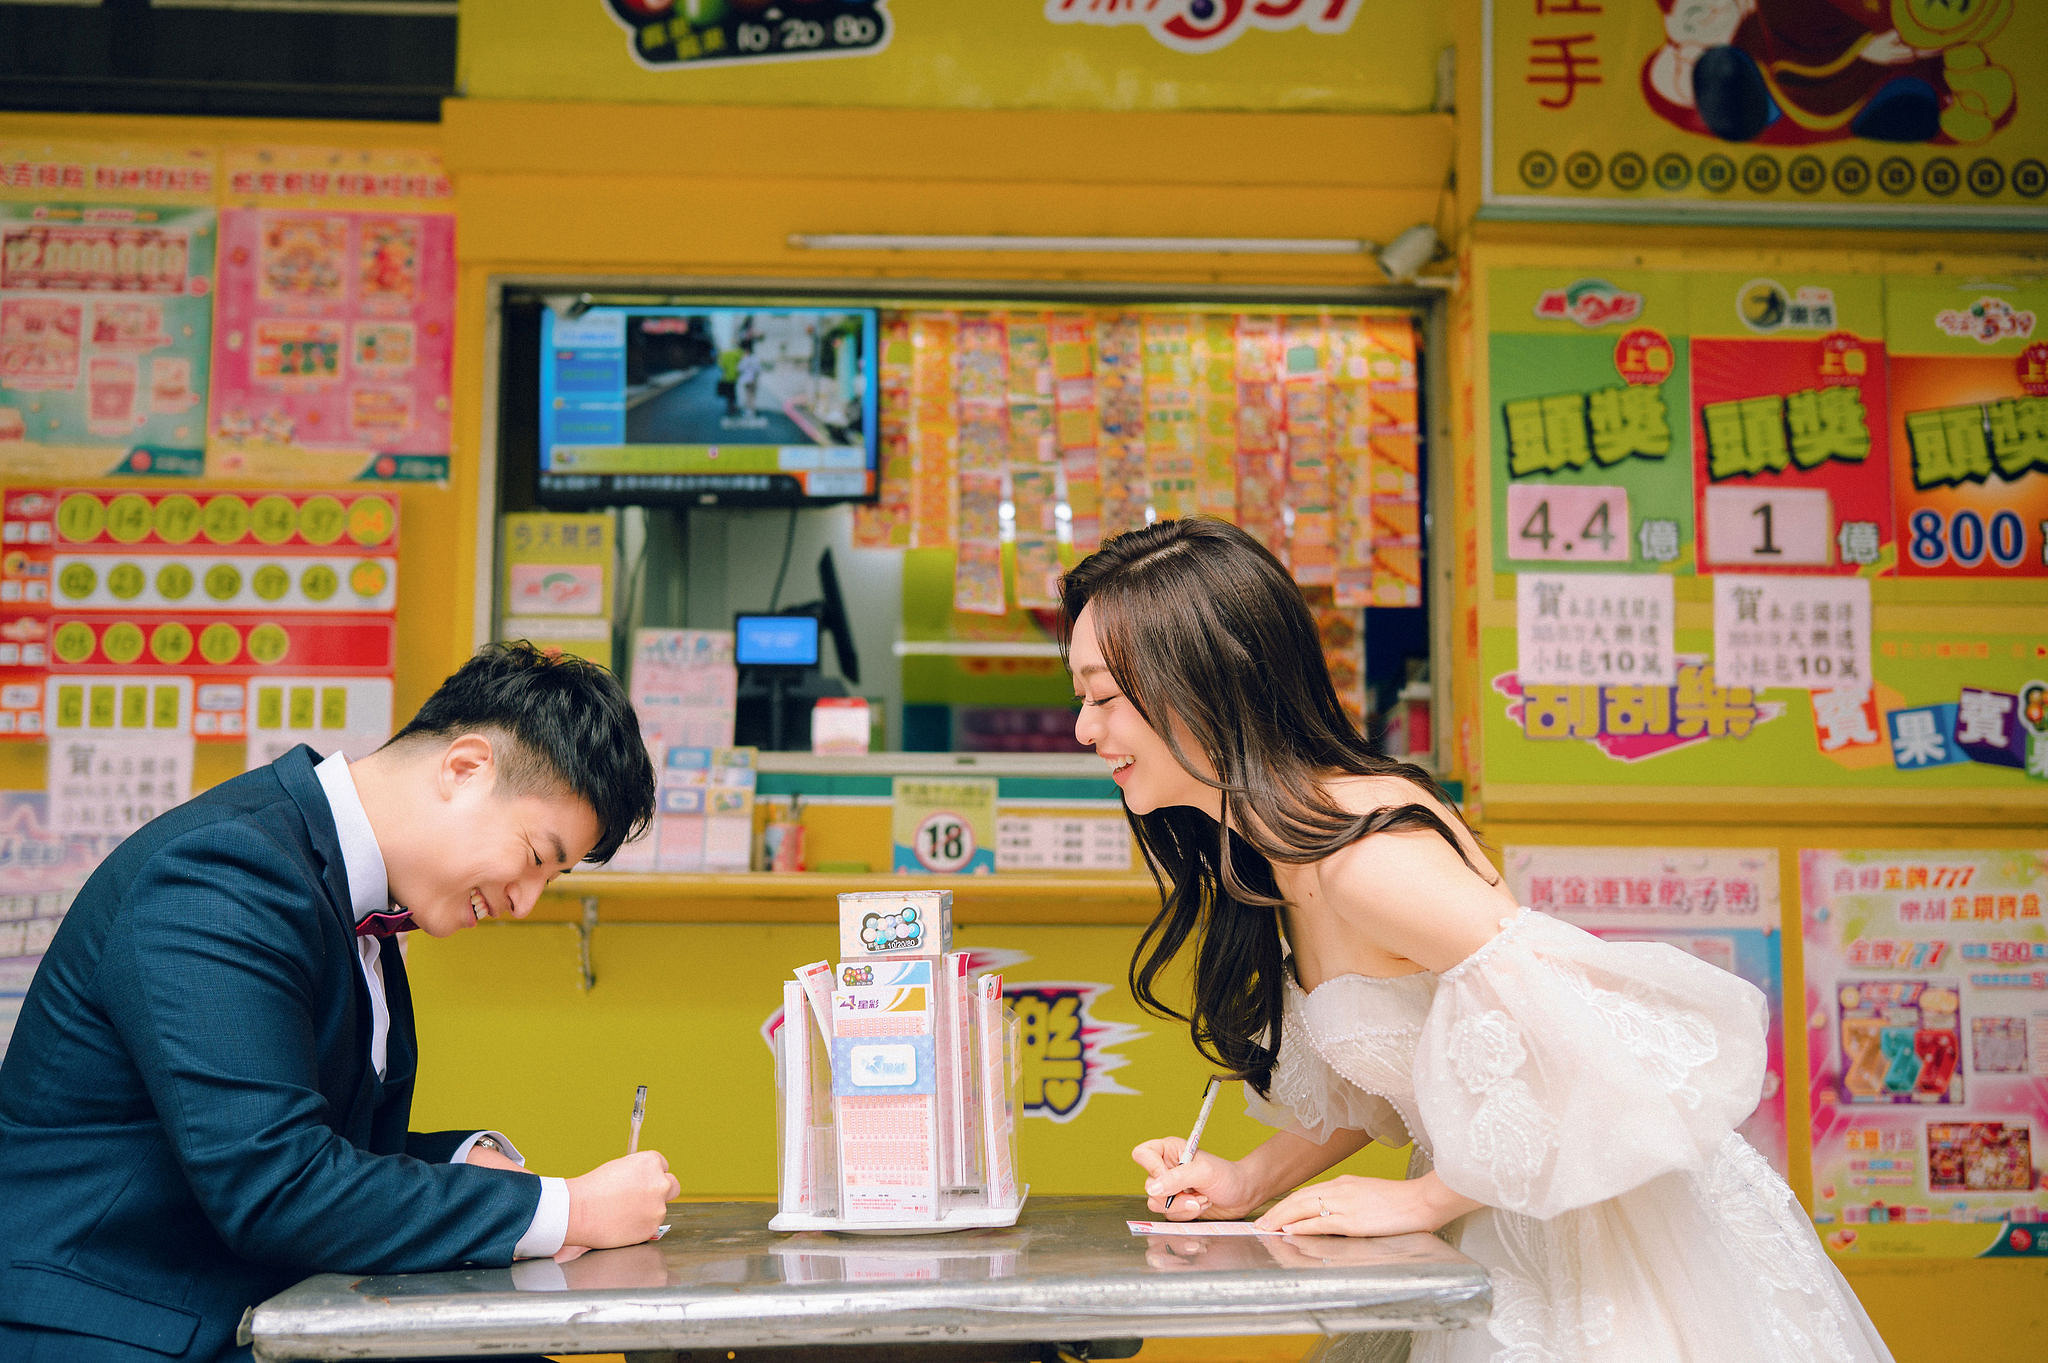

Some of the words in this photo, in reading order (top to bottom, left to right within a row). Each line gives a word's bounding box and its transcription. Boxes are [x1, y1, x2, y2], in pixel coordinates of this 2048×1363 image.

[780, 18, 825, 47] 20
[832, 14, 877, 45] 80
[1527, 0, 1602, 109] 手
[1504, 384, 1671, 479] 頭獎
[1702, 385, 1870, 482] 頭獎
[1519, 500, 1616, 552] 4.4
[1752, 504, 1782, 555] 1
[1911, 510, 2025, 563] 800
[926, 823, 963, 860] 18
